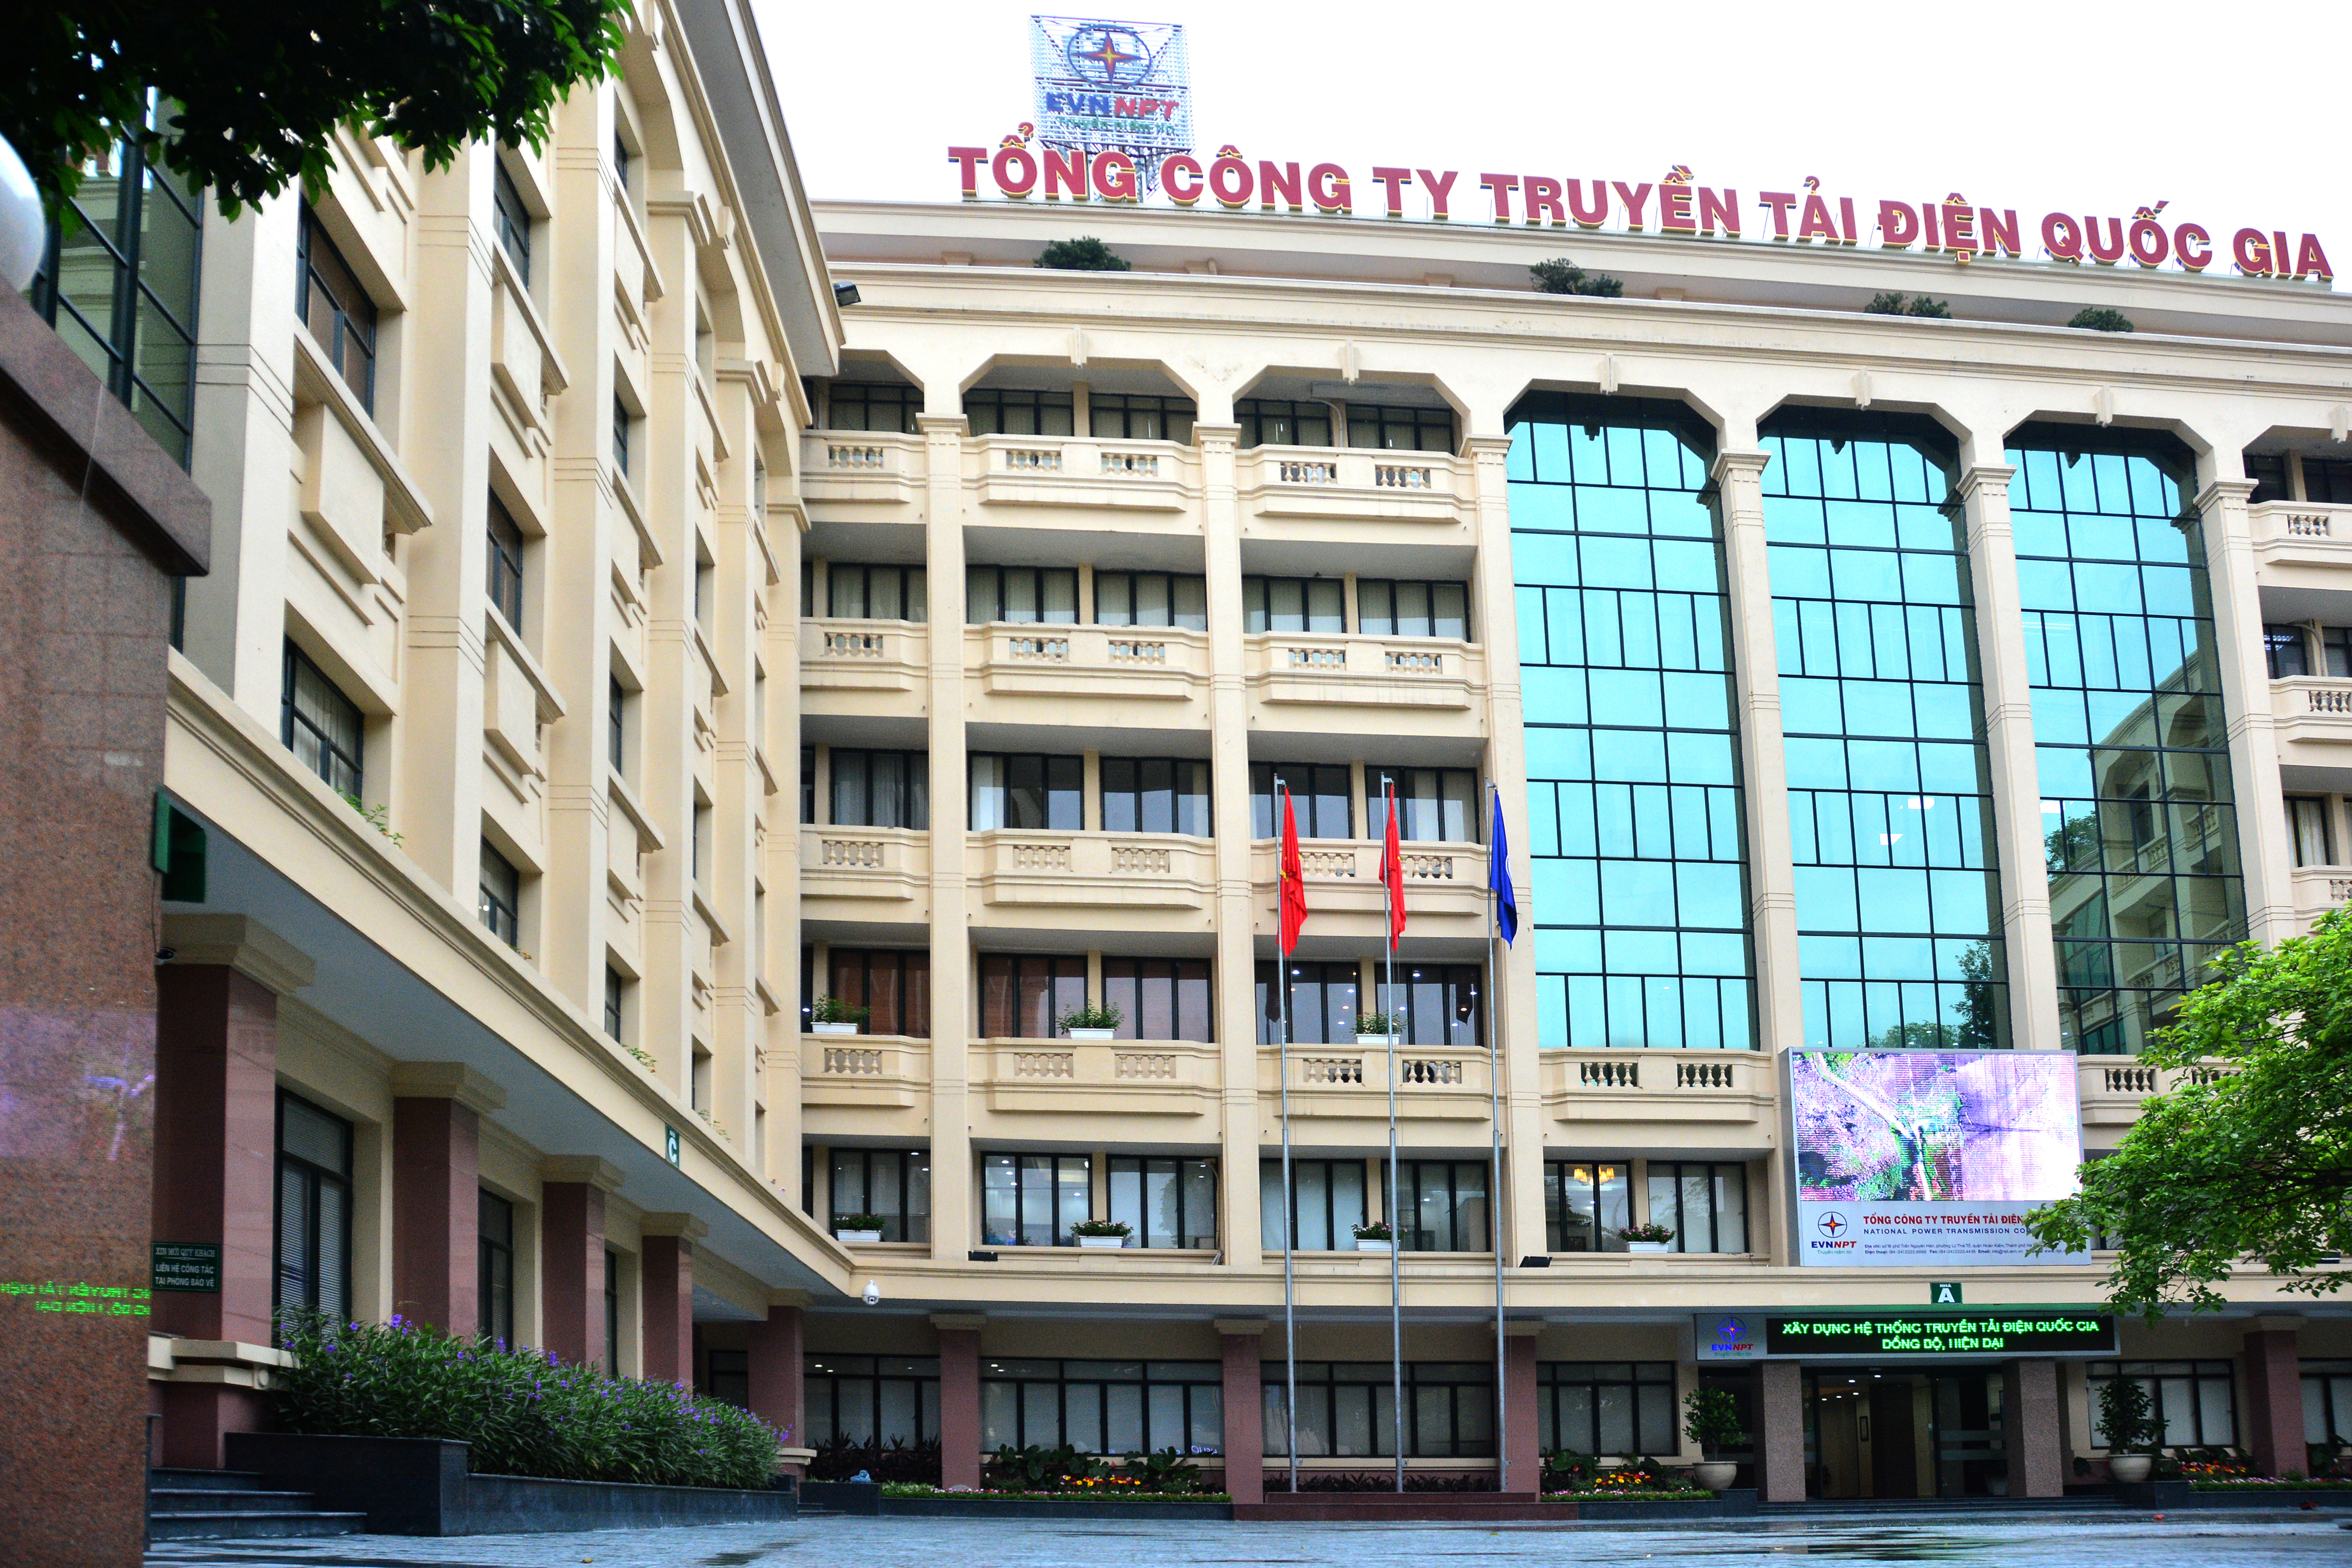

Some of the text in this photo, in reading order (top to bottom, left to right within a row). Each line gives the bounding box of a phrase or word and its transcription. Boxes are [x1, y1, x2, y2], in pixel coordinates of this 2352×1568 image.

[1045, 92, 1179, 118] EVNNPT
[948, 122, 2334, 281] TỔNG CÔNG TY TRUYỀN TẢI ĐIỆN QUỐC GIA
[668, 1137, 677, 1163] C
[1863, 1212, 1891, 1224] TỔNG
[1894, 1214, 1922, 1224] CÔNG
[1925, 1216, 1938, 1224] TY
[1941, 1213, 1980, 1224] TRUYỀN
[1982, 1213, 1998, 1224] TẢI
[194, 1247, 215, 1257] KHÁCH
[156, 1262, 170, 1272] LIÊN
[181, 1263, 200, 1273] CÔNG
[201, 1264, 214, 1274] TÁC
[155, 1276, 165, 1287] TẠI
[206, 1277, 214, 1289] VỆ
[1938, 1288, 1955, 1303] A
[1782, 1321, 1810, 1334] XÂY
[1854, 1321, 1873, 1336] HỆ
[2002, 1319, 2033, 1334] ĐIỆN
[2036, 1318, 2074, 1332] QUỐC
